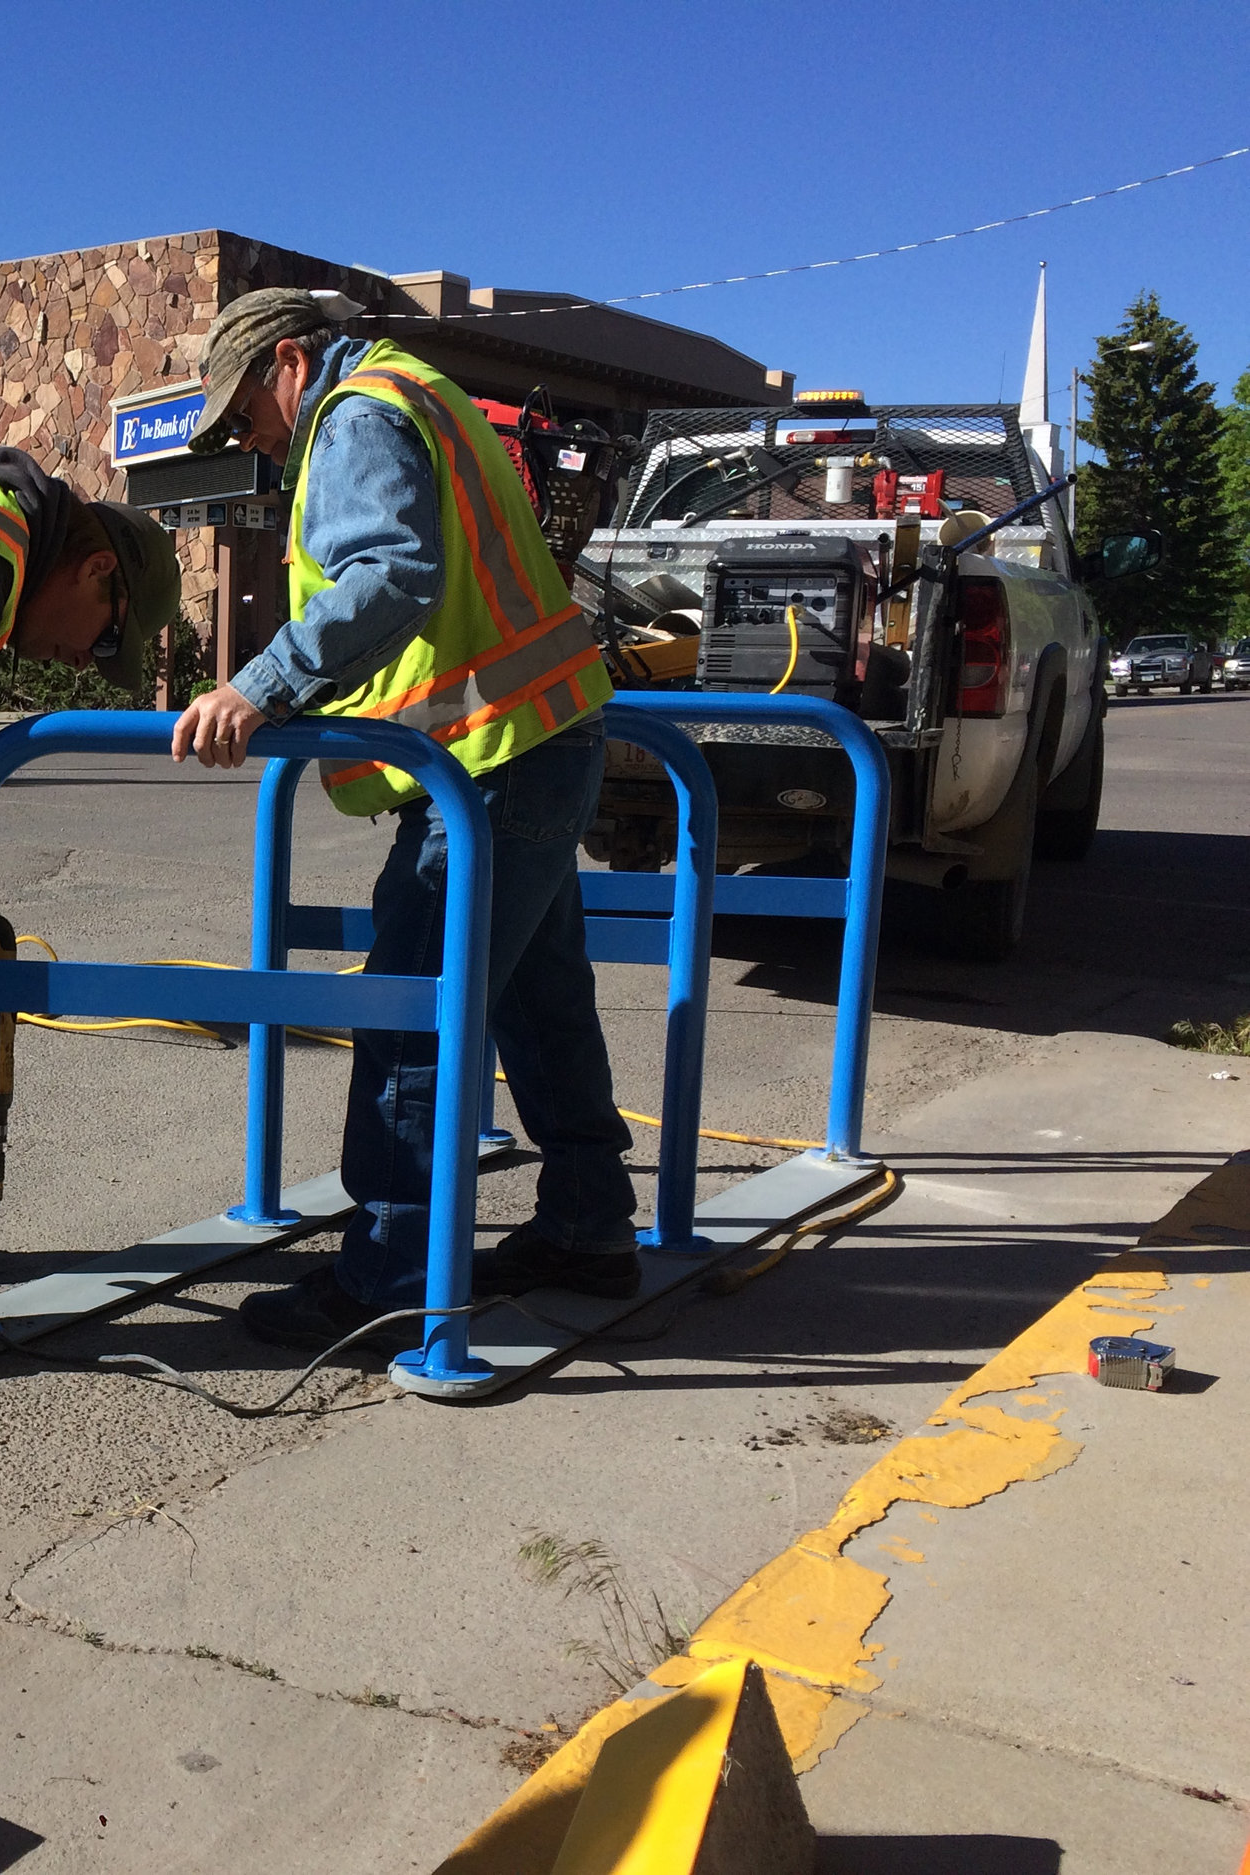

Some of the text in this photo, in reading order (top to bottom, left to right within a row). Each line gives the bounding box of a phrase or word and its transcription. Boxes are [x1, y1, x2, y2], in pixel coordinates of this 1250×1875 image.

[141, 423, 153, 440] The
[152, 414, 178, 440] Bank
[178, 409, 192, 440] of
